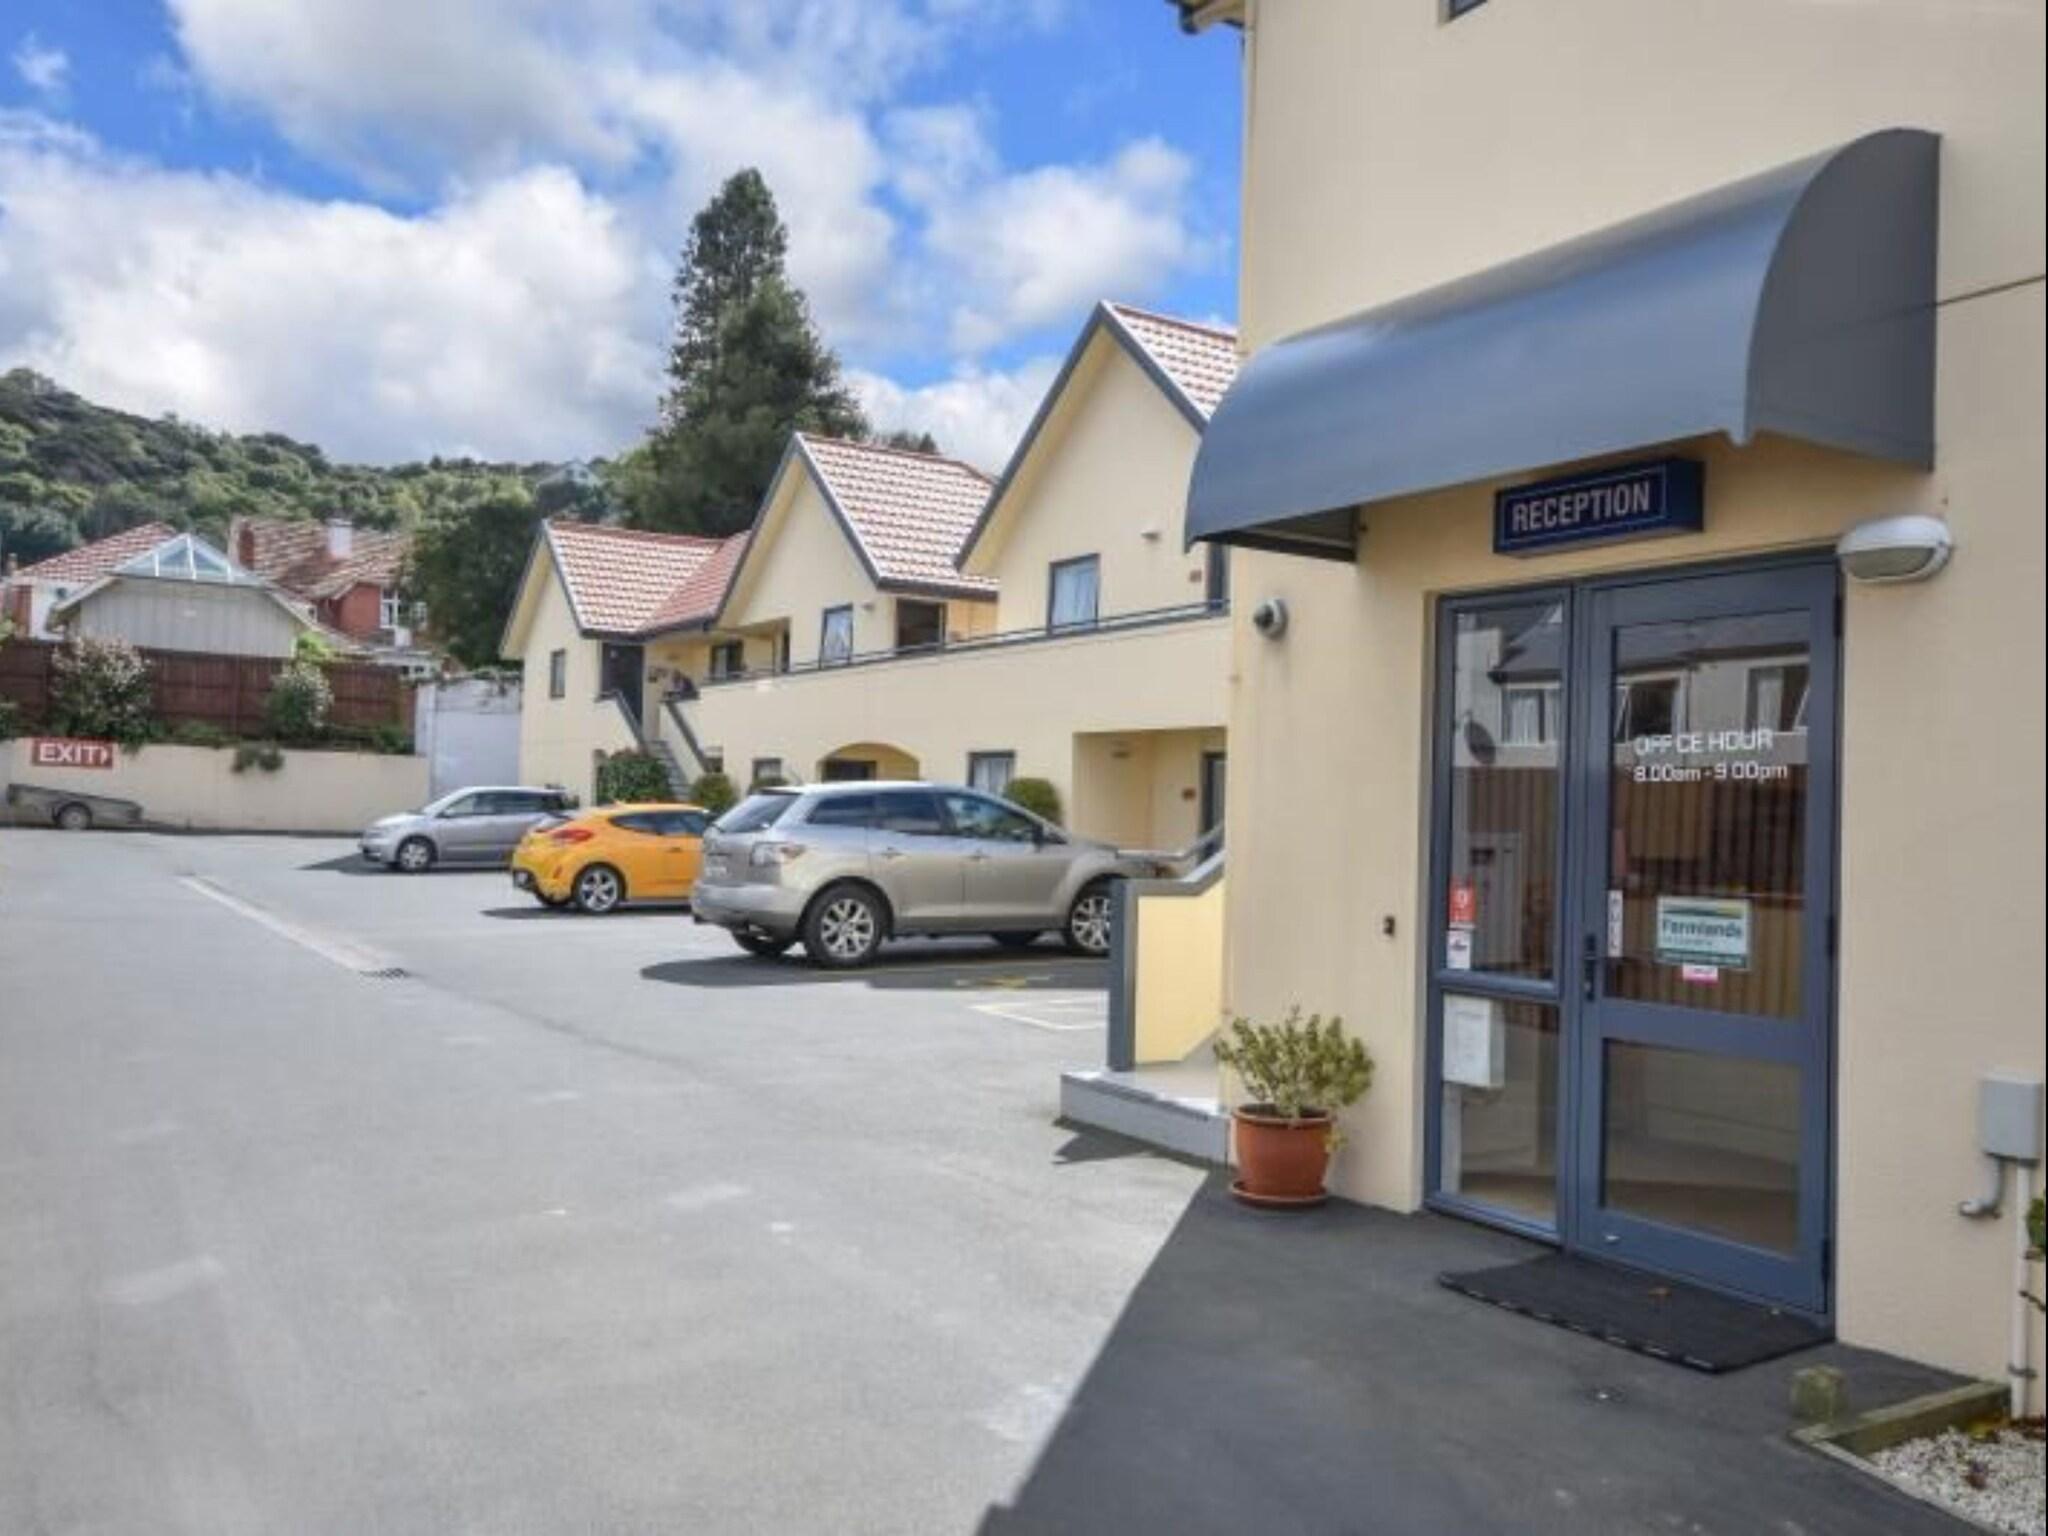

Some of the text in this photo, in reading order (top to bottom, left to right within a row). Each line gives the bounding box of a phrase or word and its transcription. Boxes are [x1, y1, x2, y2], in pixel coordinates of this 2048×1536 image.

[1512, 482, 1650, 531] RECEPTION
[40, 742, 104, 764] EXIT
[1635, 727, 1774, 755] OFFCE HOUR
[1714, 761, 1788, 783] 900pm
